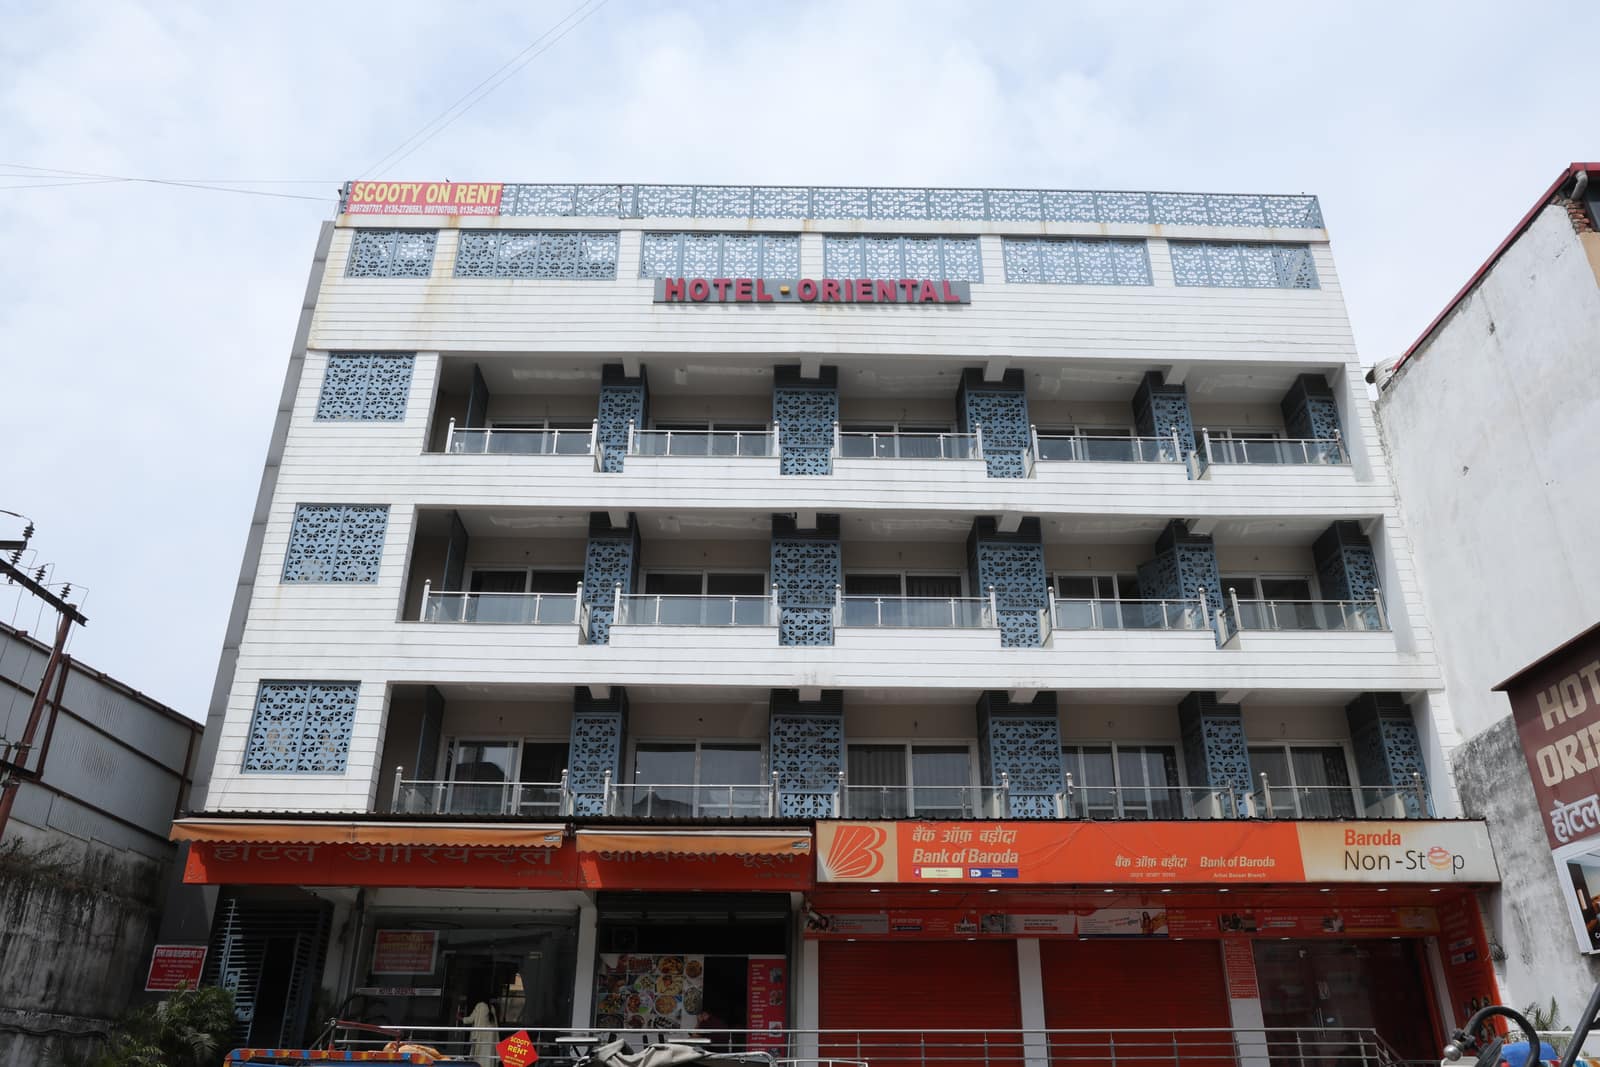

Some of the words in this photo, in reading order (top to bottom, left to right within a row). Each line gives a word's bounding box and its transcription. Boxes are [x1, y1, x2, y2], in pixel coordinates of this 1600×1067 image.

[352, 183, 422, 203] SCOOTY
[425, 184, 450, 203] ON
[454, 184, 500, 204] RENT
[664, 278, 773, 301] HOTEL
[797, 278, 961, 302] ORIENTAL
[1344, 829, 1401, 846] Baroda
[912, 848, 949, 863] Bank
[951, 848, 967, 863] of
[968, 848, 1019, 863] Baroda
[1200, 856, 1226, 867] Bank
[1228, 856, 1238, 867] of
[1240, 856, 1276, 867] Baroda
[507, 1045, 529, 1057] RENT
